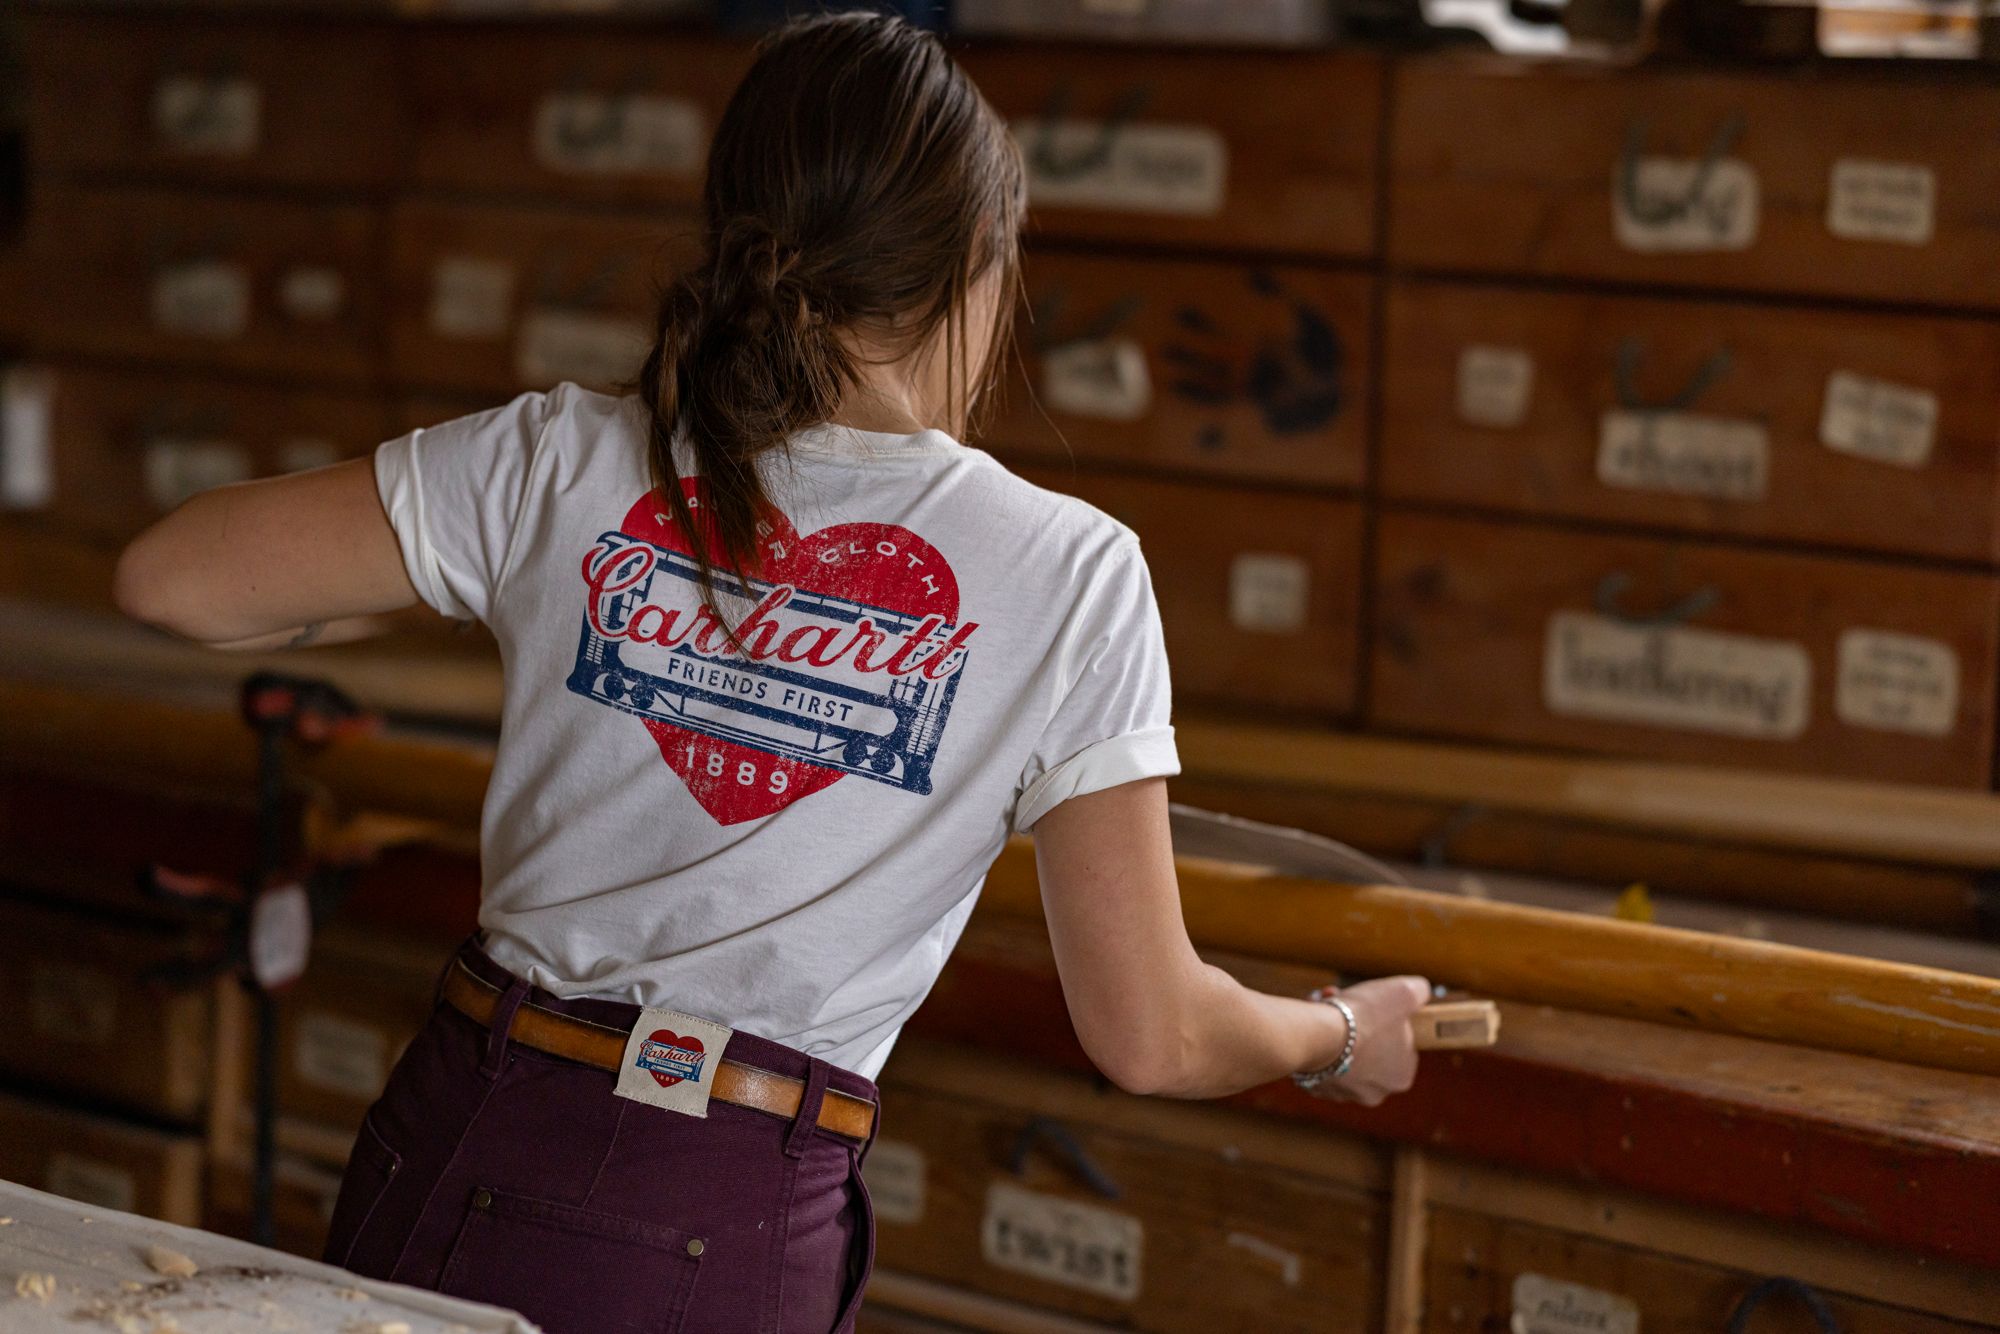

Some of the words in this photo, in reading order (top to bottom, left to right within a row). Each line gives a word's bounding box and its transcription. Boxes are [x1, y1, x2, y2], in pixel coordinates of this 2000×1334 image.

[655, 496, 787, 561] MAER
[819, 541, 940, 596] CLOTH
[581, 543, 980, 680] Carhartt
[667, 658, 769, 700] FRIENDS
[781, 689, 855, 722] FIRST
[684, 745, 790, 795] 1889
[640, 1040, 707, 1063] Carhartt
